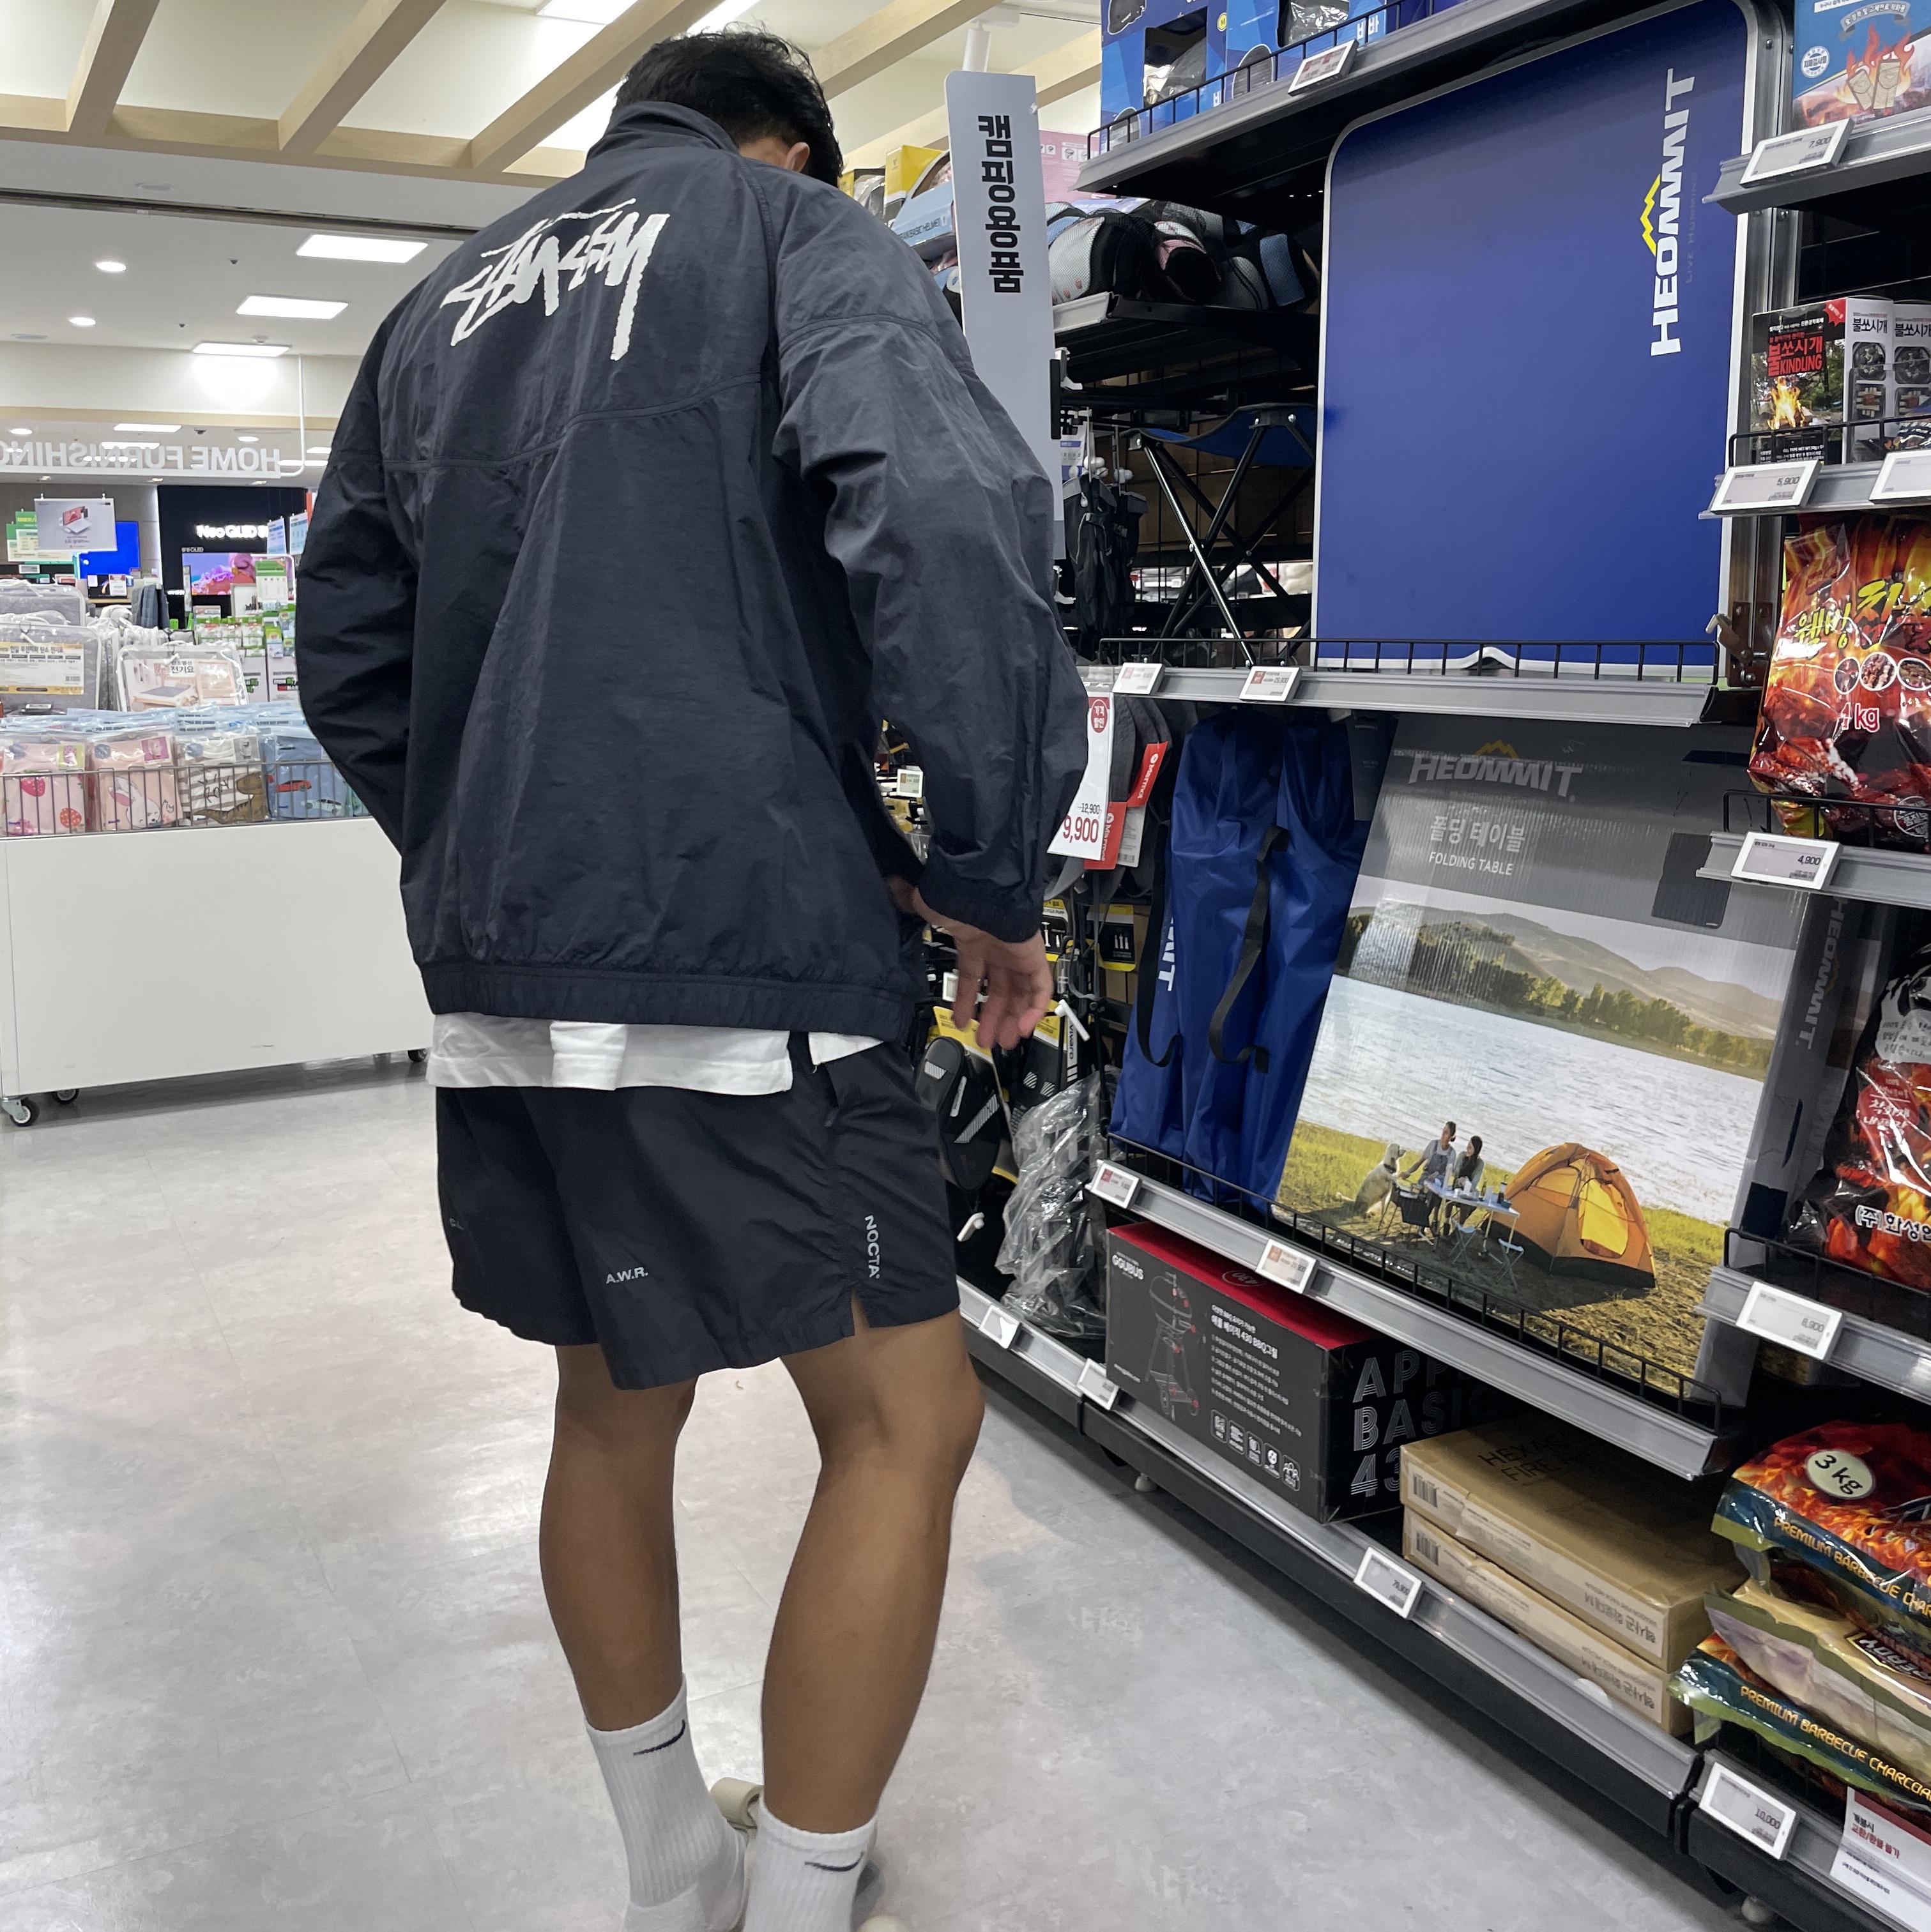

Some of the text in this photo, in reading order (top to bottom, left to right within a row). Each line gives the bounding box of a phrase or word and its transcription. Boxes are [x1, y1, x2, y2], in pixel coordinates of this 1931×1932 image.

[978, 115, 1024, 294] 캠핑용품
[1852, 318, 1888, 334] 불쏘시개
[1767, 334, 1824, 377] 불쏘시개
[1780, 354, 1823, 376] KINDLING
[196, 525, 225, 538] Neo
[225, 524, 258, 538] QLED
[1794, 601, 1851, 649] 웰빙
[170, 665, 194, 674] 전기요
[1854, 702, 1880, 733] kg
[1081, 802, 1100, 815] 12,900
[1063, 814, 1099, 844] 9,900
[1430, 816, 1525, 853] 폴딩 테이블
[1428, 851, 1515, 876] FOLDING TABLE
[1797, 855, 1821, 867] 4,900
[606, 1266, 649, 1284] A.W.R.
[1815, 1454, 1863, 1495] 3 kg
[1774, 1516, 1831, 1558] PREMIUM
[1833, 1550, 1901, 1598] BARBECUE
[1740, 1685, 1931, 1804] PREMIUM BARBECUE CHARCOA
[1754, 1807, 1782, 1830] 10,000
